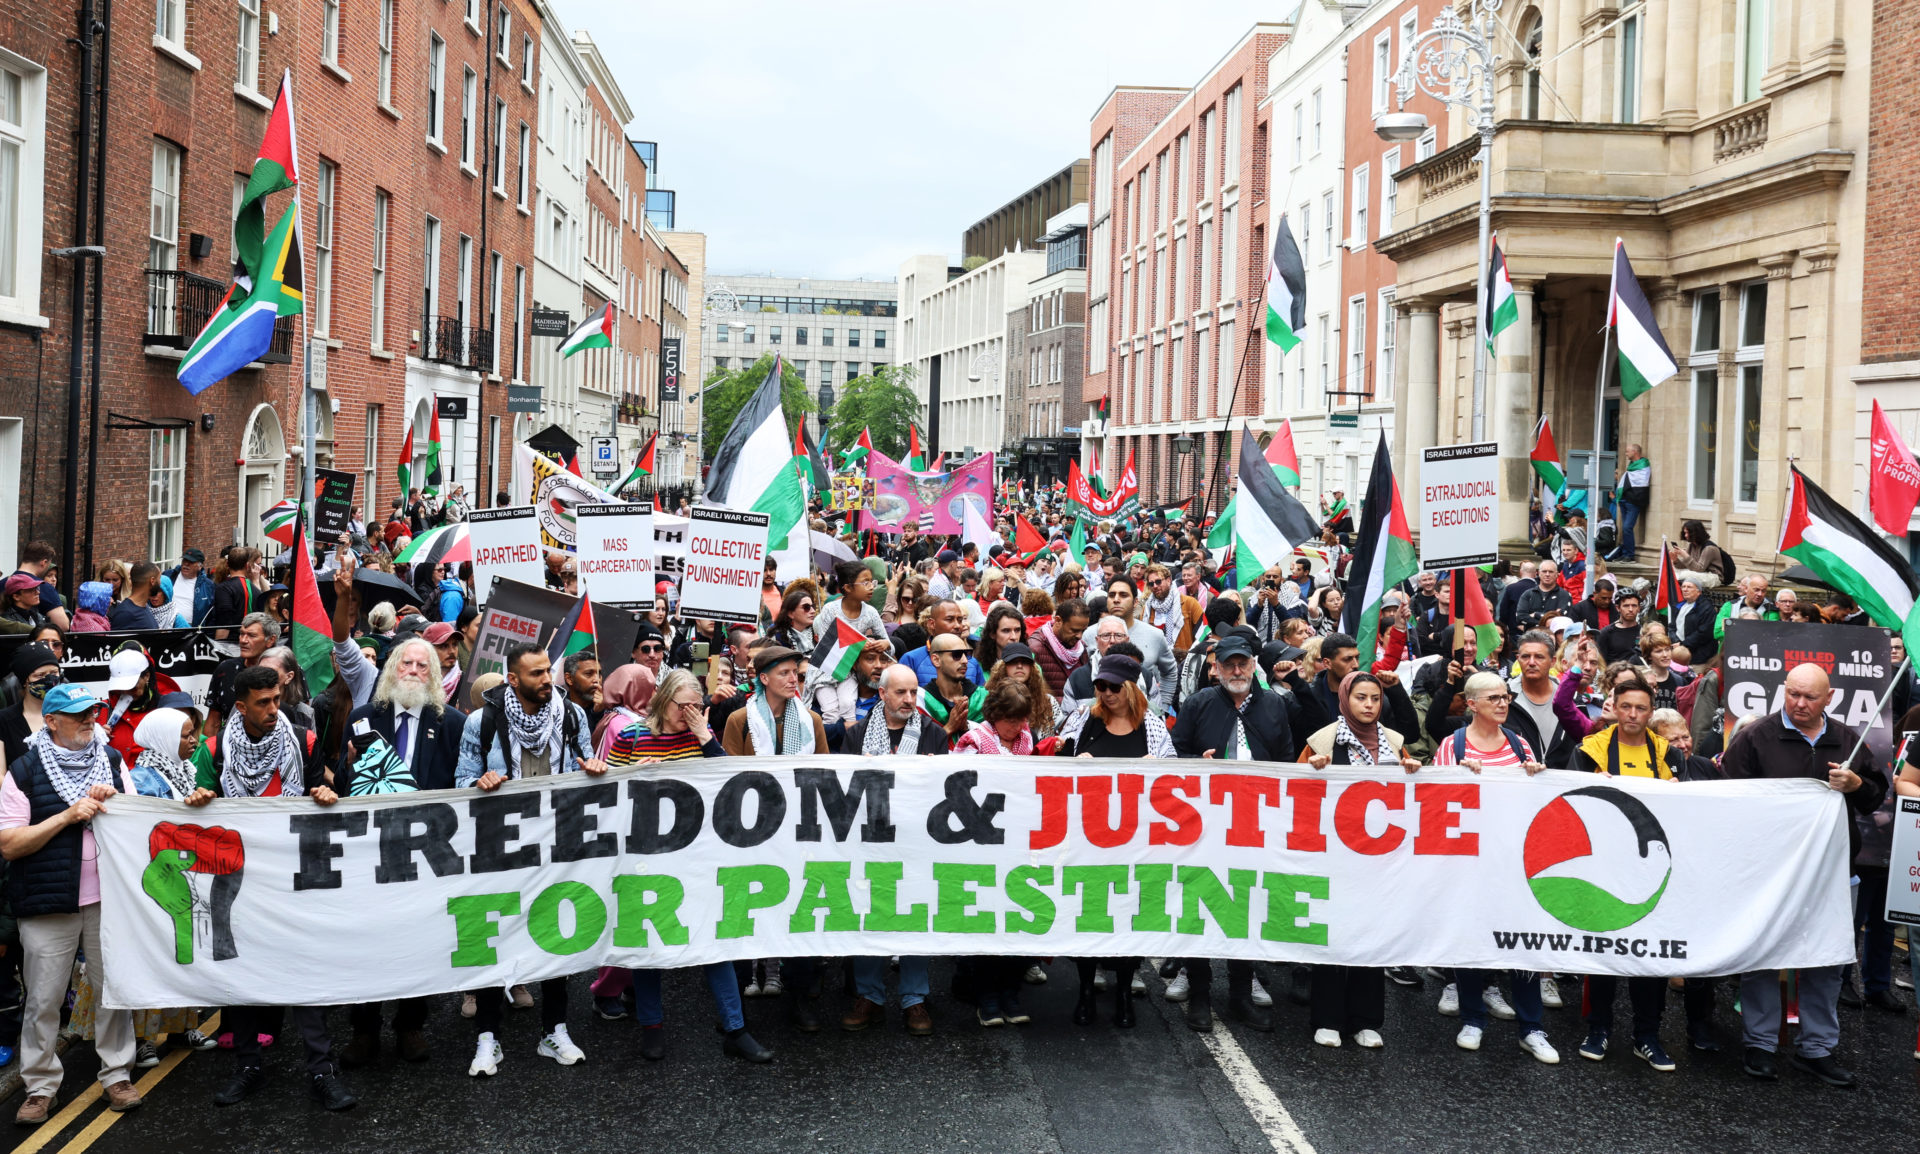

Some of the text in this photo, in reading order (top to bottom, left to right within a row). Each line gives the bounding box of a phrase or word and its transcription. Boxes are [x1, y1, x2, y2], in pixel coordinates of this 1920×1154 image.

[1426, 445, 1496, 459] ISRAELI WAR CRIME
[330, 480, 349, 488] Stand
[1883, 465, 1920, 489] PROFIT
[1425, 480, 1496, 503] EXTRAJUDICIAL
[323, 496, 351, 506] Palestine
[579, 506, 608, 514] ISRAELI
[626, 505, 651, 513] CRIME
[325, 510, 343, 518] Stand
[470, 508, 534, 520] ISRAELI WAR CRIME
[693, 510, 767, 524] ISRAELI WAR CRIME
[1432, 506, 1490, 528] EXECUTIONS
[603, 538, 628, 552] MASS
[691, 536, 762, 561] COLLECTIVE
[476, 543, 538, 566] APARTHEID
[580, 558, 651, 574] INCARCERATION
[686, 564, 761, 589] PUNISHMENT
[489, 612, 539, 638] CEASE
[482, 632, 520, 657] FIR
[1749, 643, 1759, 657] 1
[158, 648, 187, 669] من
[1727, 655, 1783, 672] CHILD
[1784, 649, 1836, 663] KILLED
[1851, 650, 1873, 664] 10
[1838, 662, 1885, 679] MINS
[1904, 801, 1920, 811] ISR
[289, 768, 1480, 892] FREEDOM & JUSTICE
[446, 860, 1330, 969] FOR PALESTINE
[1492, 930, 1688, 960] WWW.IPSC.IE
